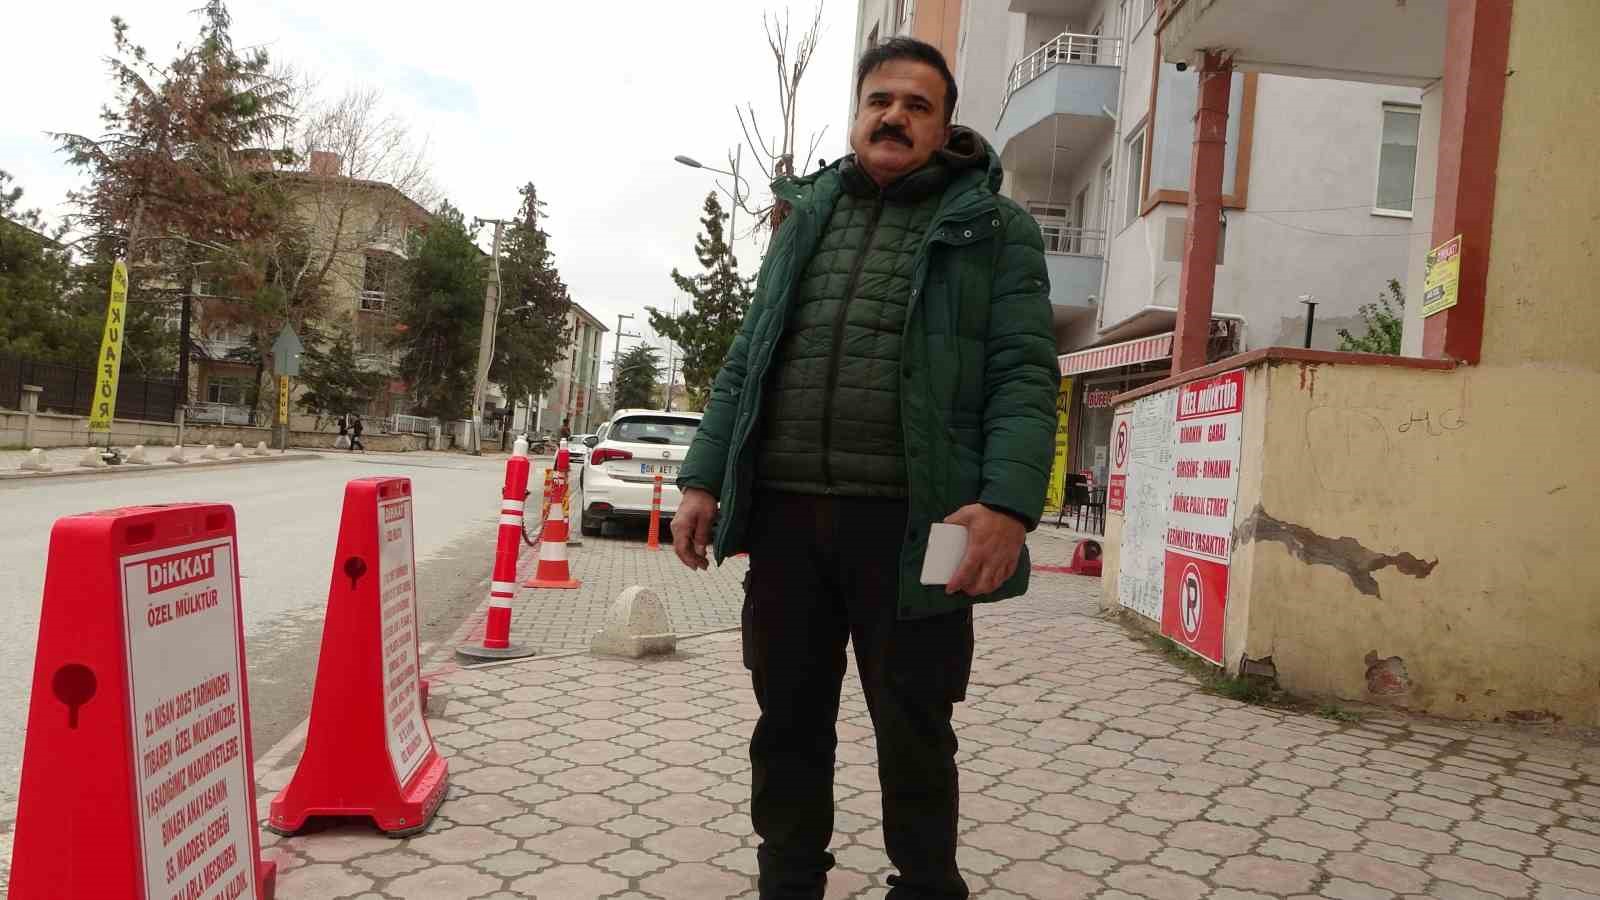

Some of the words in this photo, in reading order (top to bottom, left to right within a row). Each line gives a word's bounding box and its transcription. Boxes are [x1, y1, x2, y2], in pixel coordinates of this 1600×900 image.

[1199, 379, 1238, 412] MÜLKTÜR
[1207, 423, 1226, 443] GARAJ
[147, 602, 173, 627] ÖZEL
[176, 586, 218, 619] MÜLKTÜR
[176, 691, 192, 719] 2025
[175, 727, 192, 757] ÖZEL
